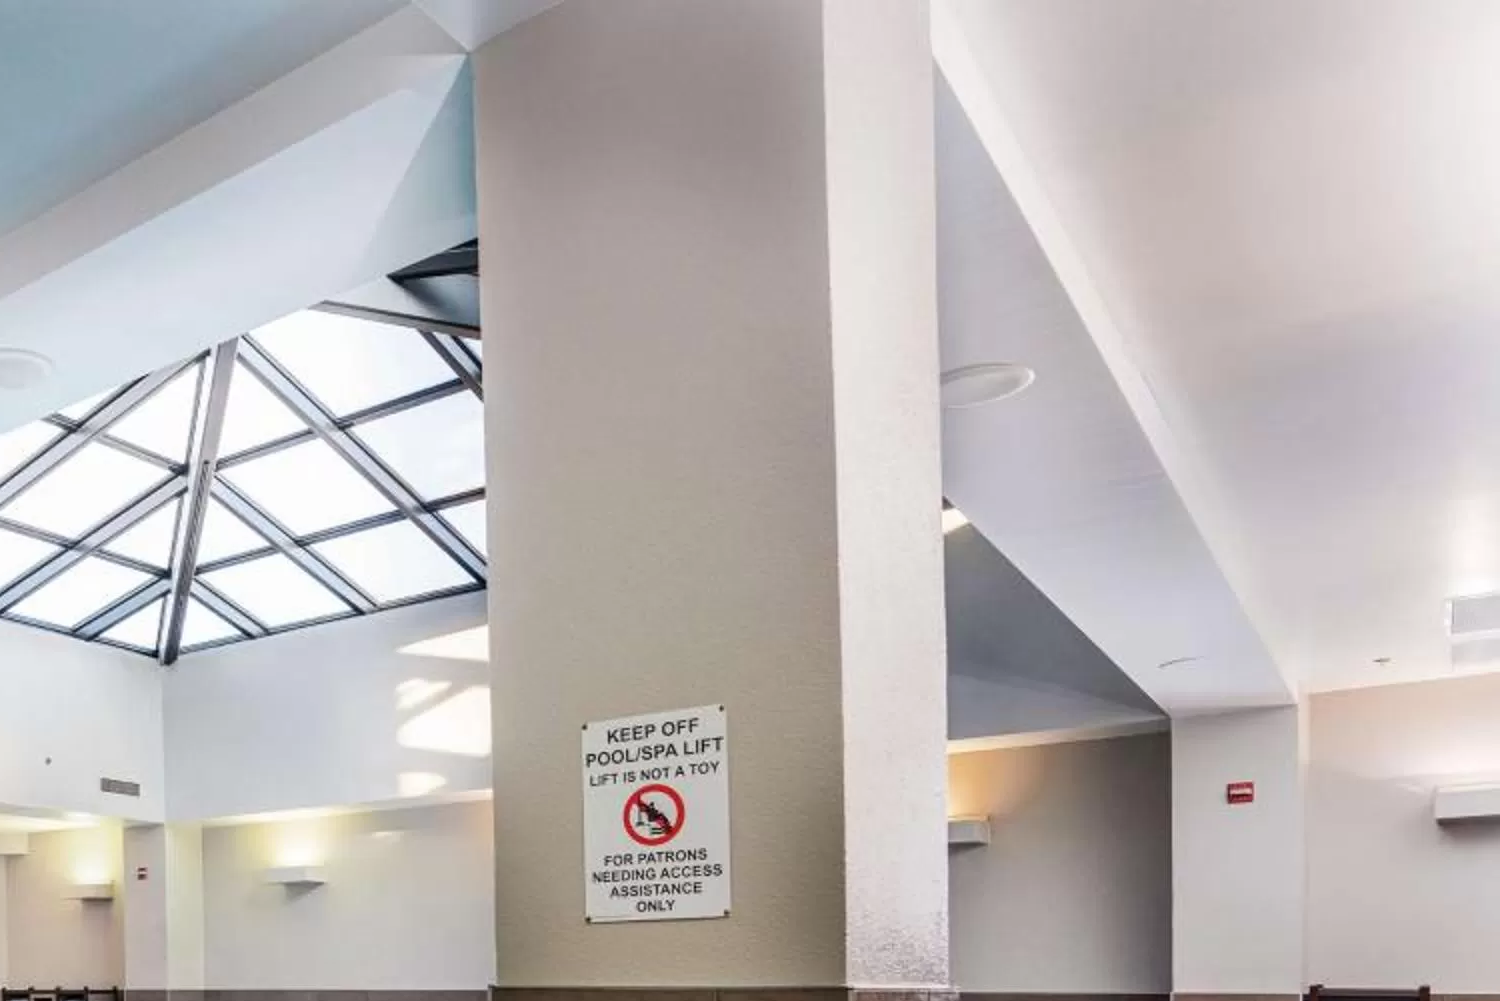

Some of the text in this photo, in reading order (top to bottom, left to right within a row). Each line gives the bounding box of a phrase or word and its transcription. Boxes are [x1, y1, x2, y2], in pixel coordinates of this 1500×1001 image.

[607, 717, 699, 744] KEEP OFF
[586, 736, 724, 768] POOL/SPA LIFT
[590, 761, 720, 787] LIFT IS NOT A TOY
[603, 847, 708, 866] FOR PATRONS
[592, 863, 723, 883] NEEDING ACCESS
[609, 881, 703, 898] ASSISTANCE
[636, 899, 675, 913] ONLY
